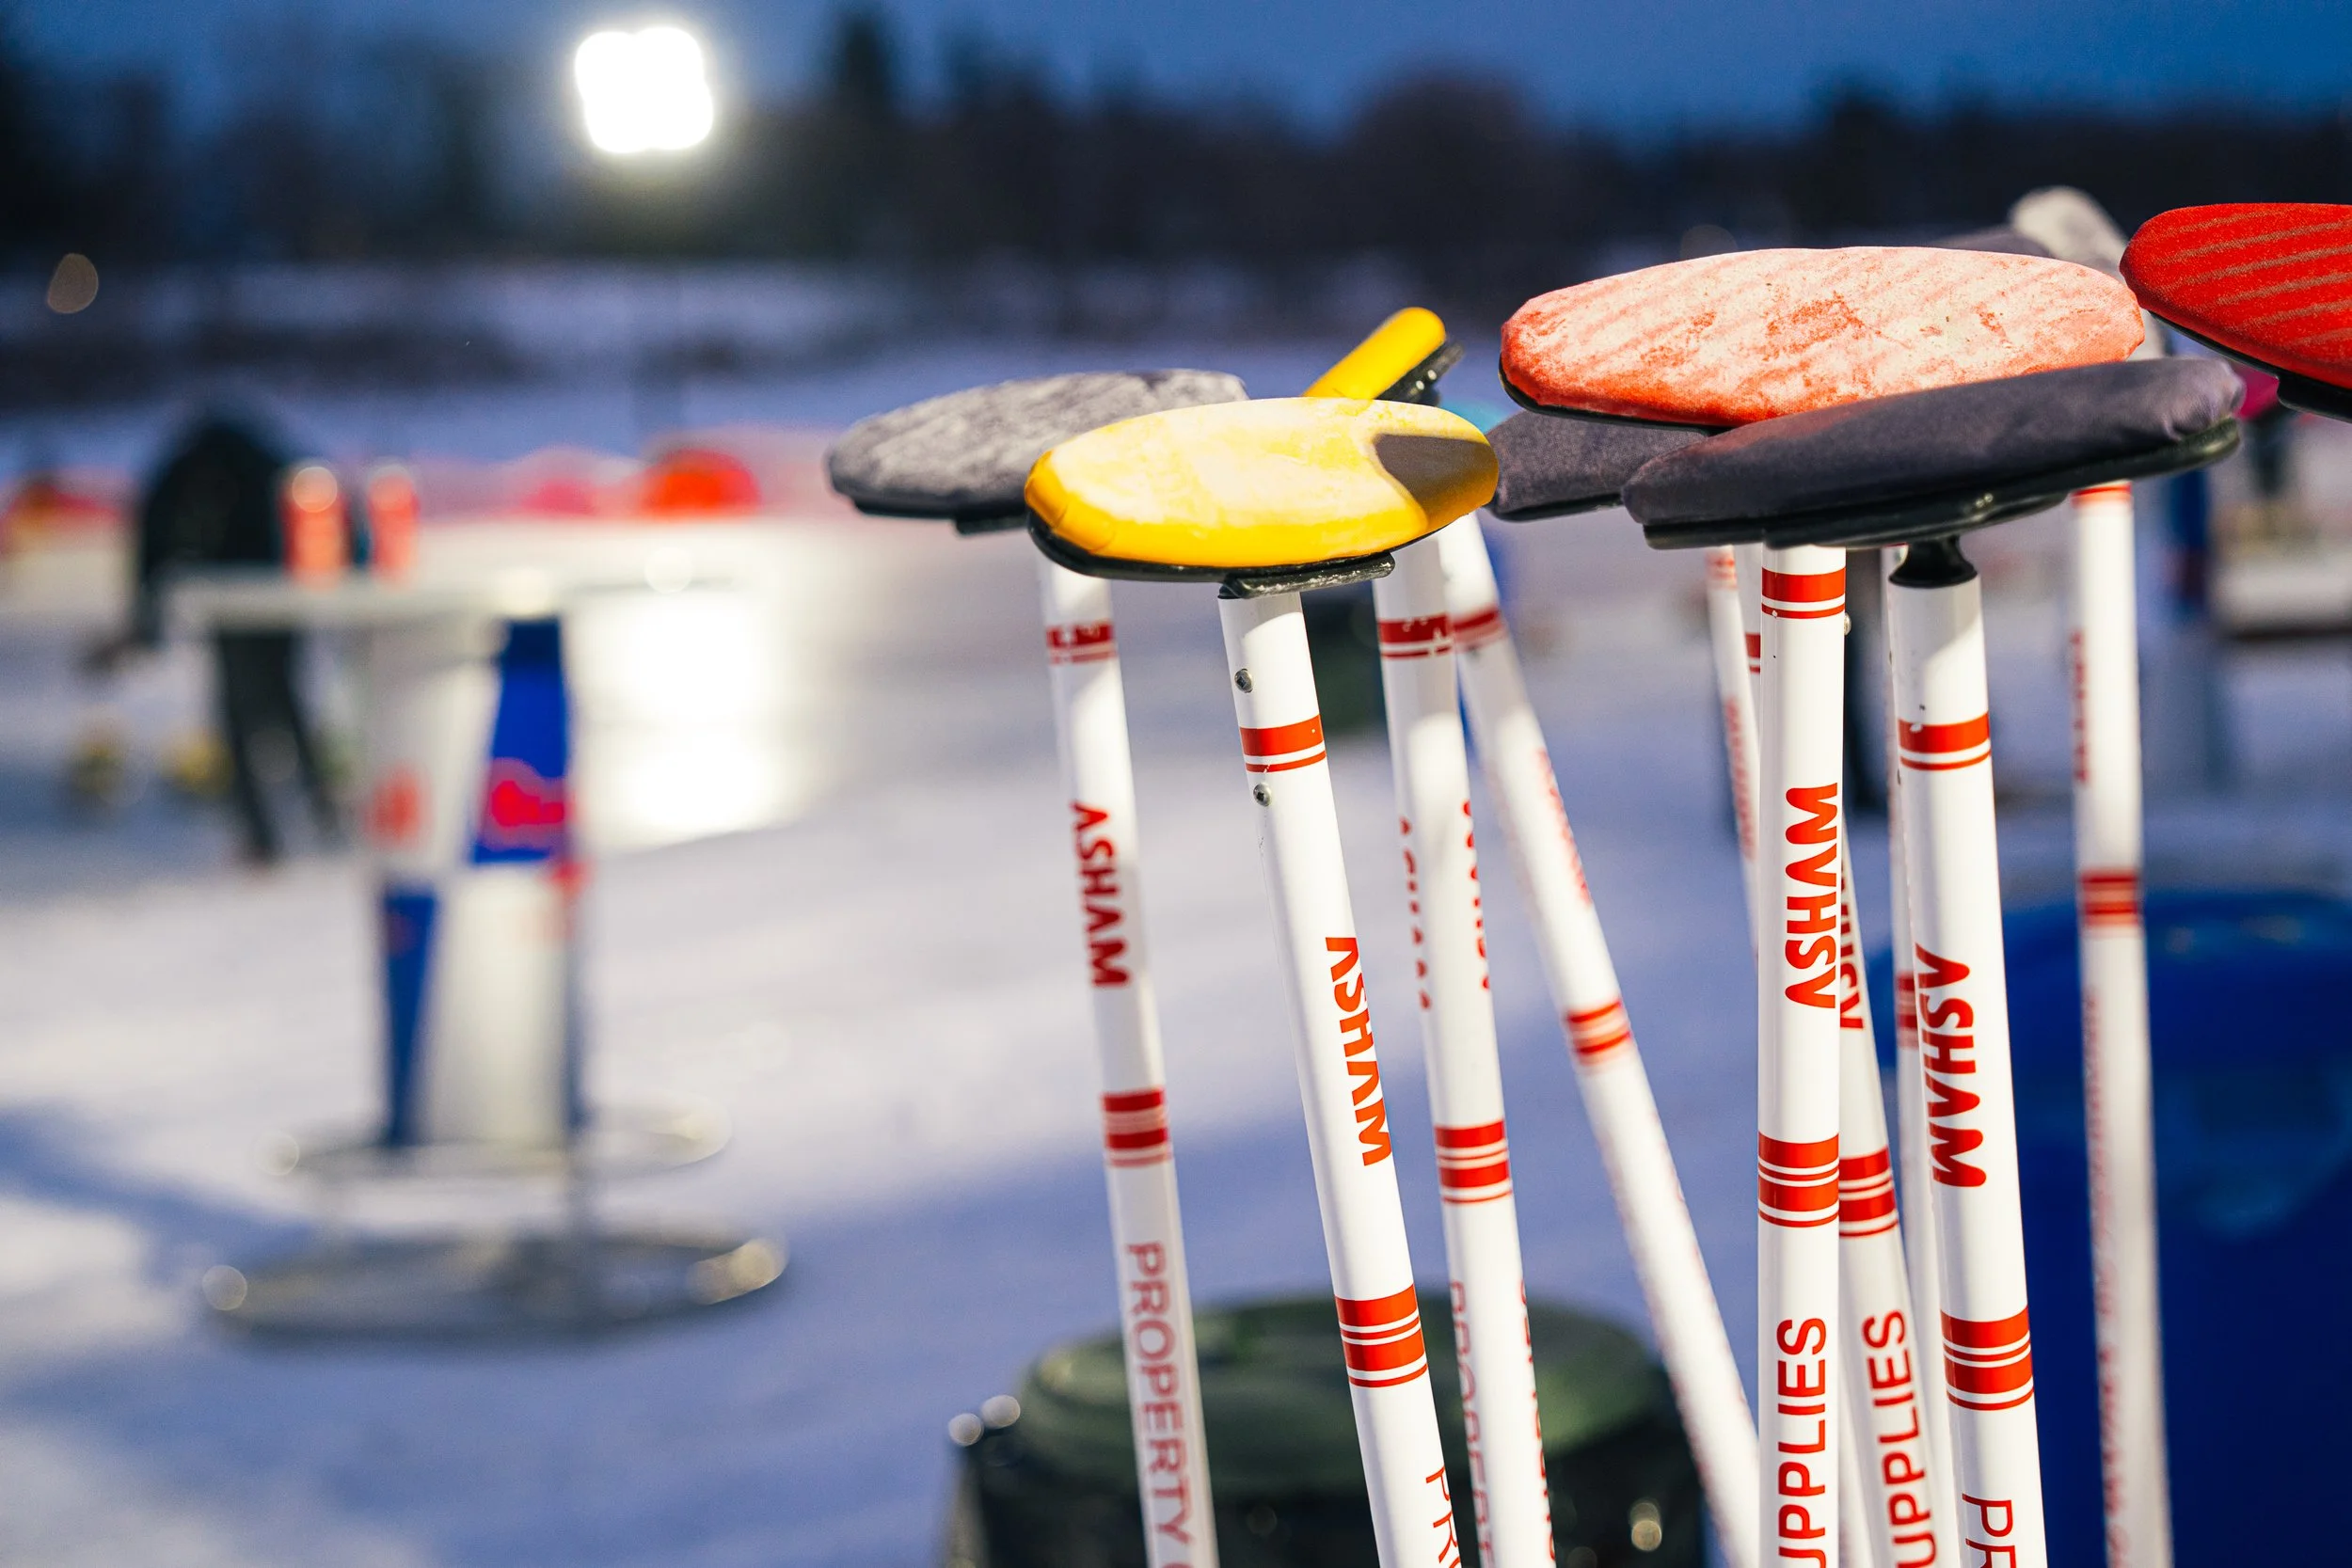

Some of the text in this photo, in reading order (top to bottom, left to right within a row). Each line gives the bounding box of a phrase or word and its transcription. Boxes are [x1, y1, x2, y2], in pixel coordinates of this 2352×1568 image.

[1071, 801, 1132, 988] ASHAM
[1784, 782, 1837, 1009] ASHAM
[1326, 937, 1392, 1166] ASHAM
[1915, 942, 1987, 1188] ASHAM
[1127, 1240, 1194, 1545] PROPERTY
